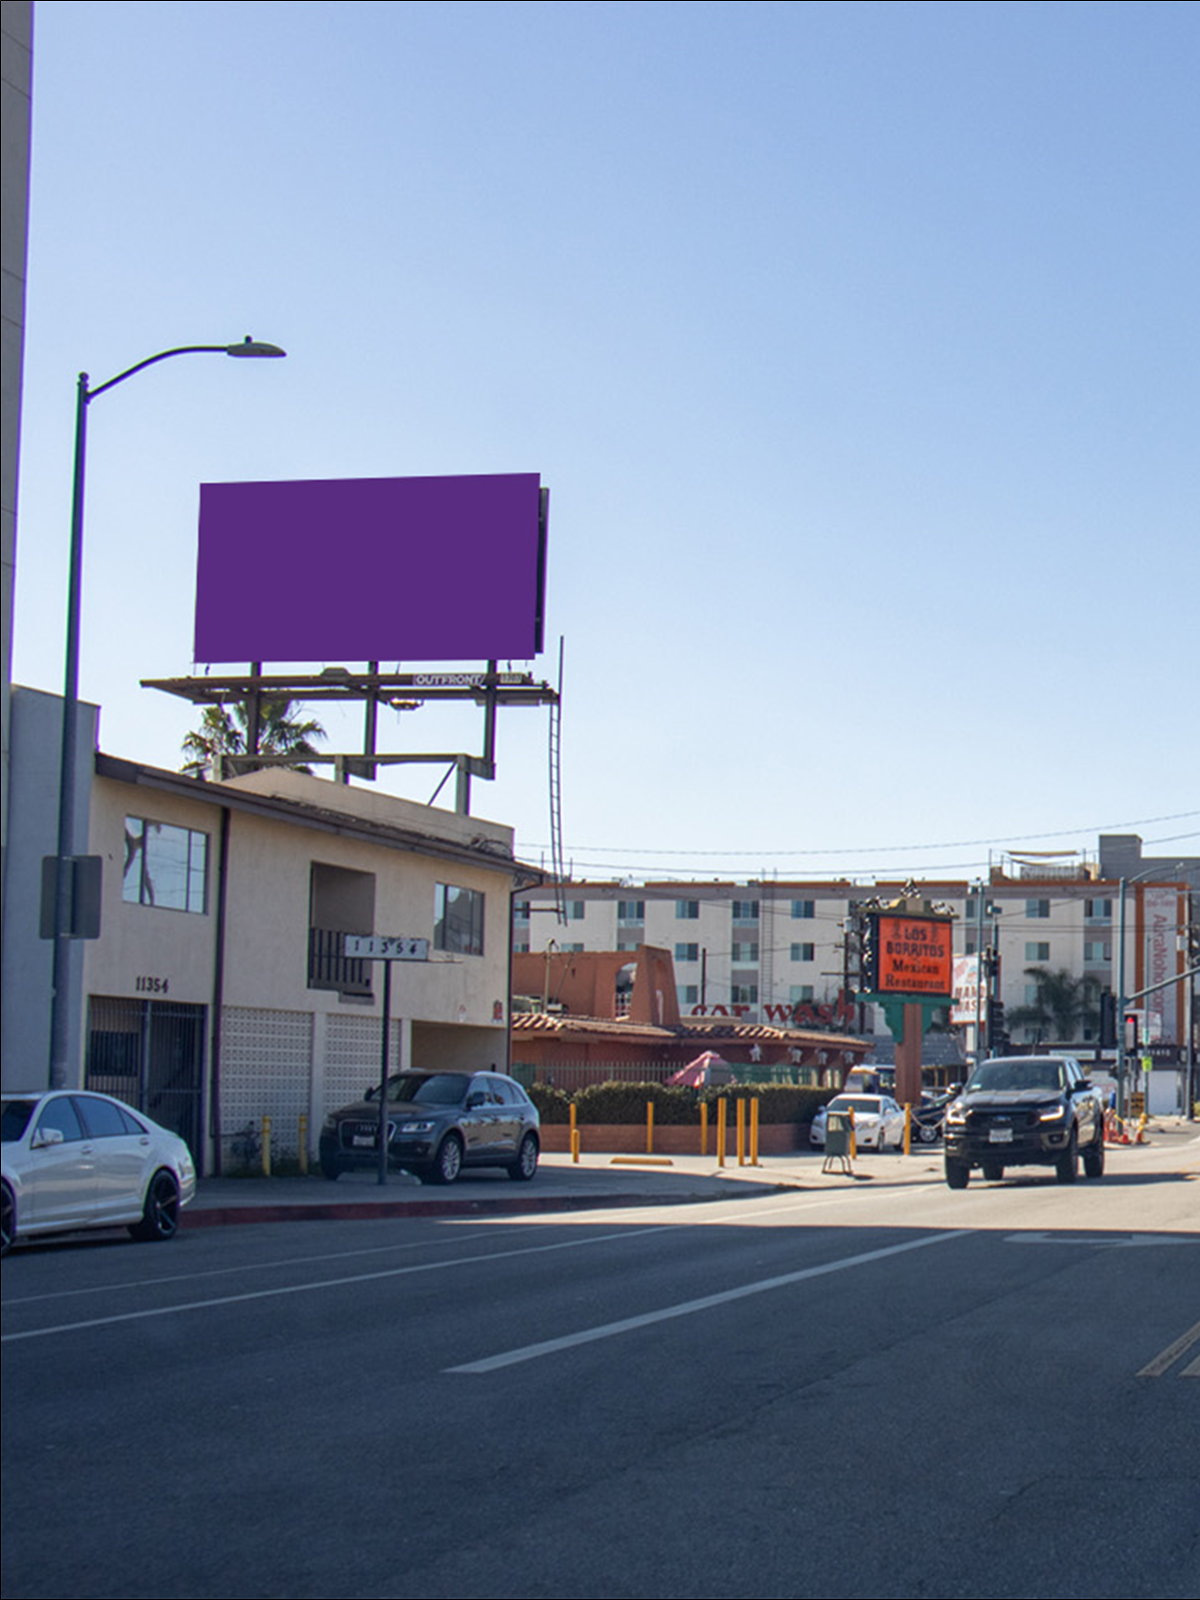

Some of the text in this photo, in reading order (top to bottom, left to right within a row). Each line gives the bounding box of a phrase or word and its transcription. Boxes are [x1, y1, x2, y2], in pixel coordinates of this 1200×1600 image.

[416, 674, 482, 685] OUTFRONT
[904, 928, 927, 941] LOS
[354, 940, 417, 955] 11354
[892, 959, 939, 974] Mexican
[1153, 913, 1168, 1017] AuraNohocom
[136, 976, 168, 994] 11354
[885, 974, 945, 989] Restaurant
[763, 988, 855, 1024] wash
